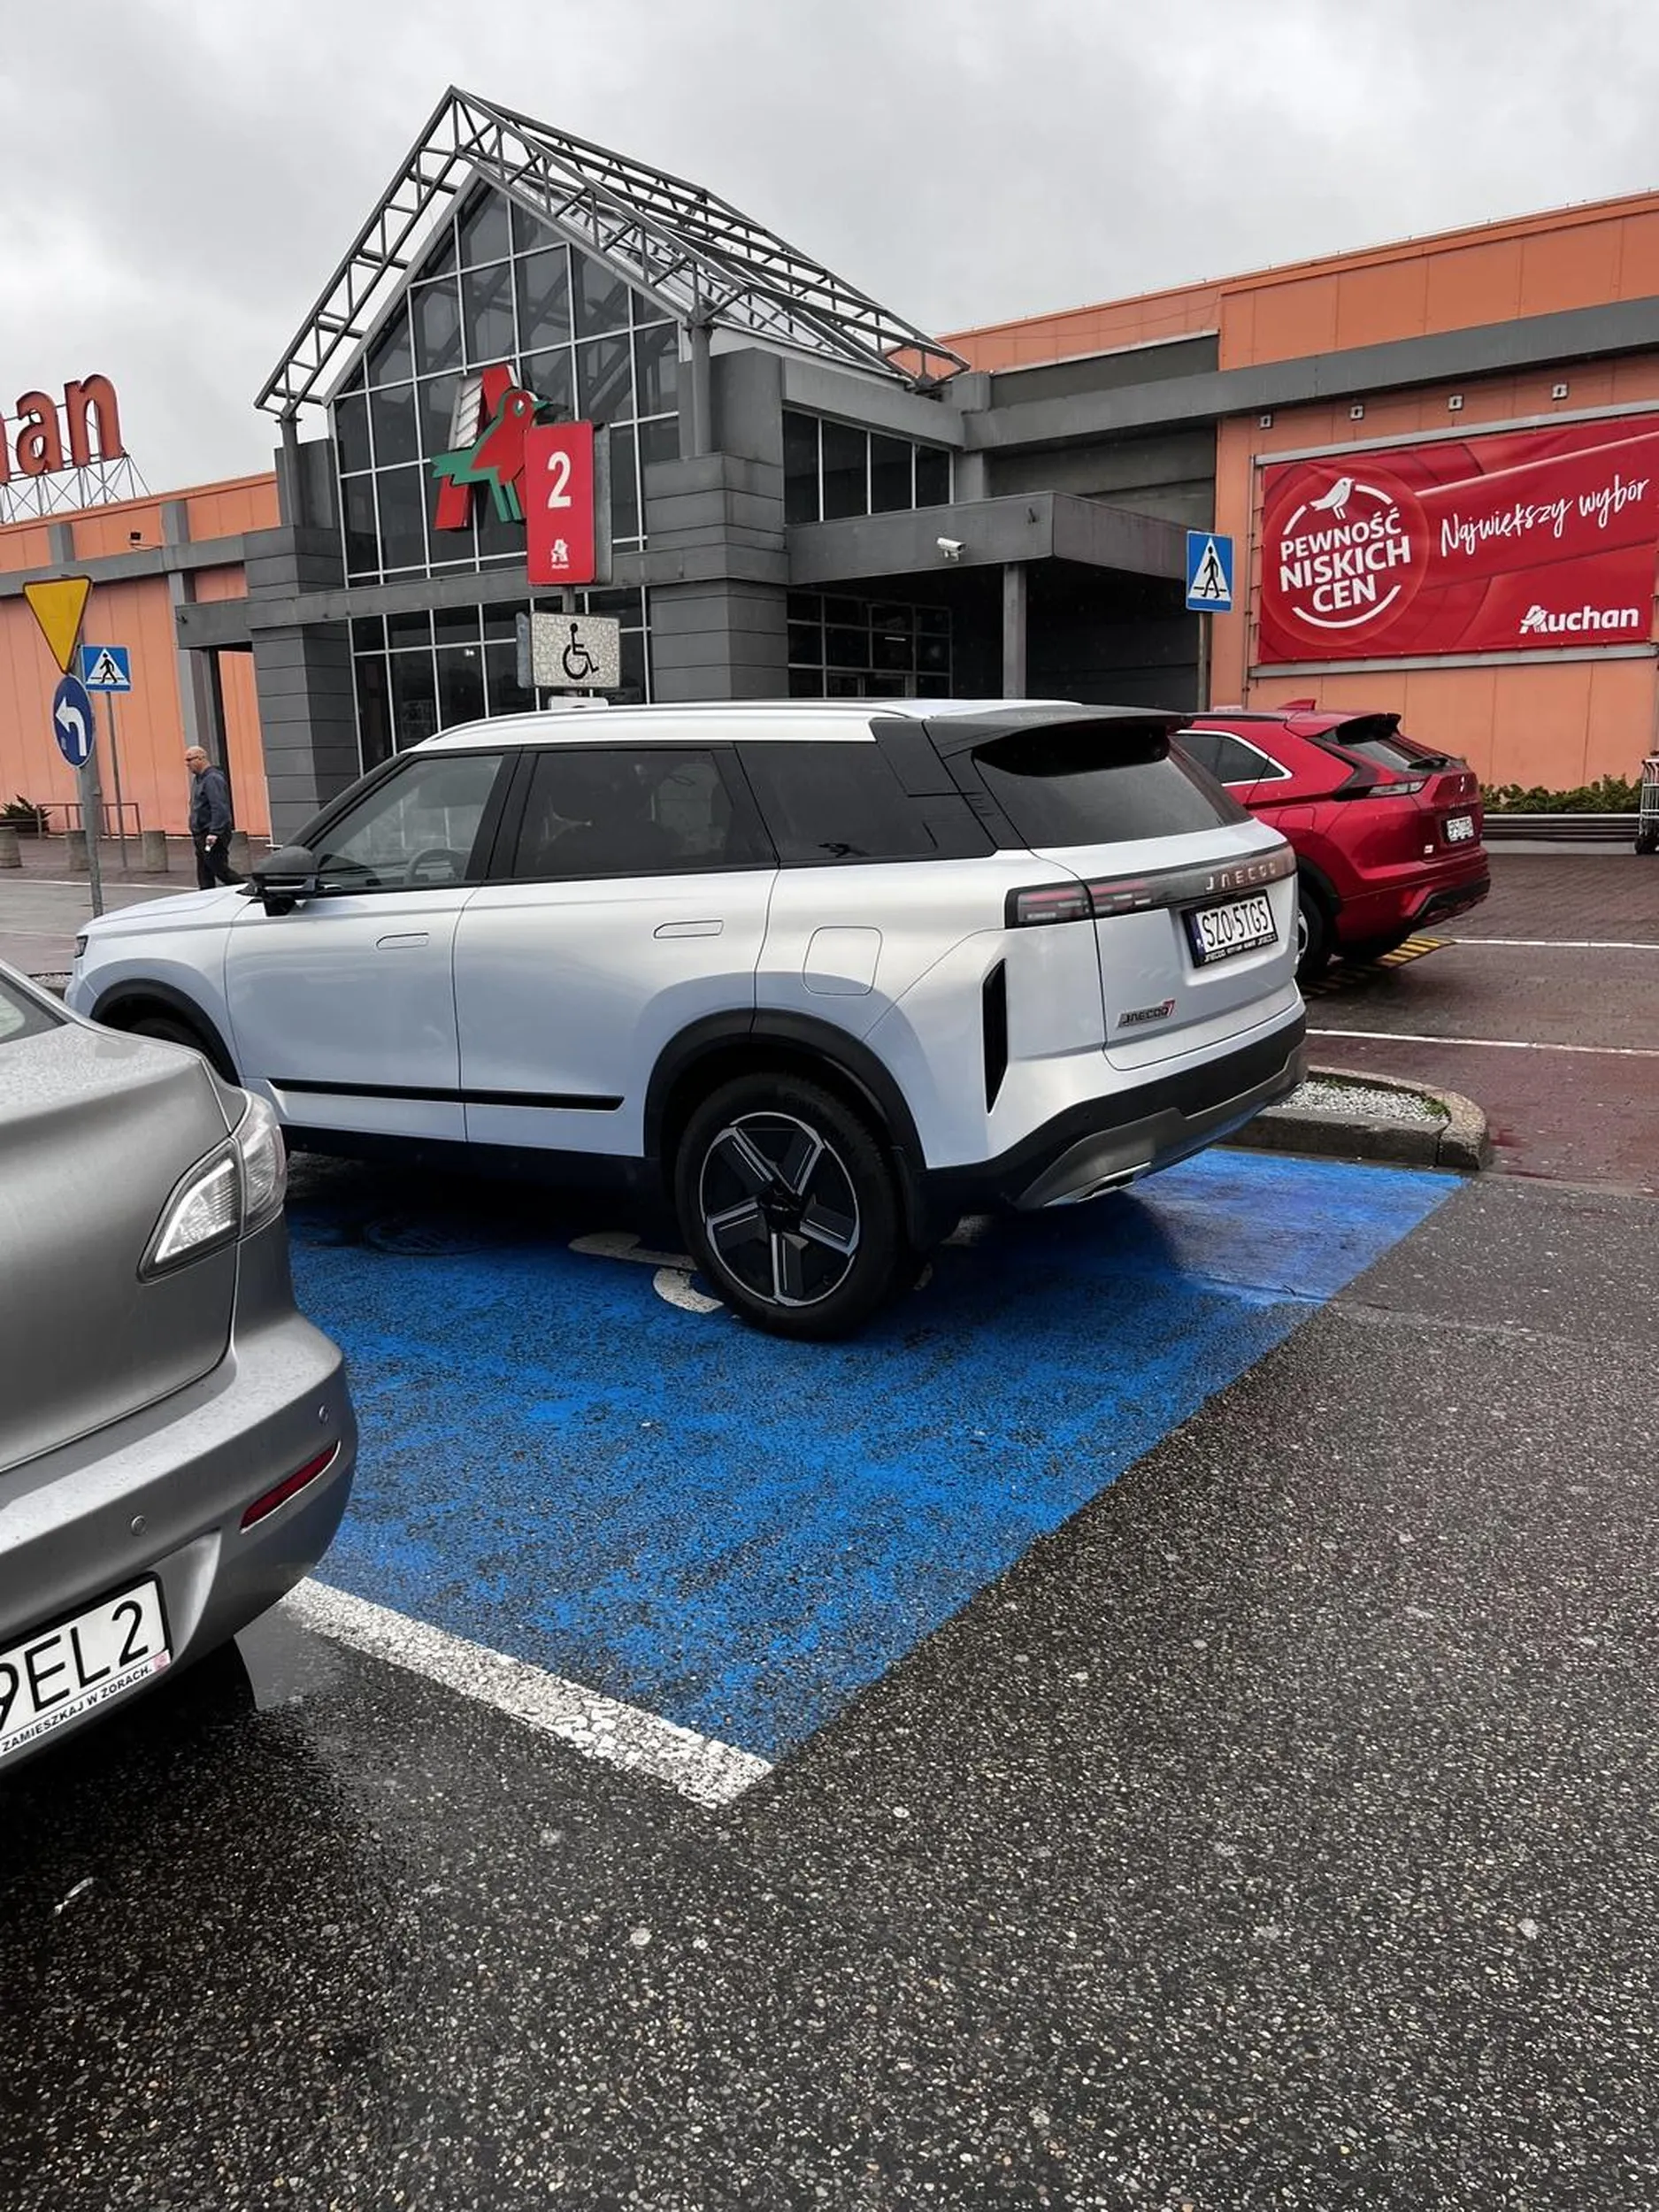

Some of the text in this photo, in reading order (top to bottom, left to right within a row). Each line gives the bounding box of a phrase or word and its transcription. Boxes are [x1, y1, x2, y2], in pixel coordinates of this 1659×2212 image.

[0, 373, 125, 484] an
[547, 450, 572, 510] 2
[1280, 507, 1402, 562] PEWNOŚĆ
[1440, 473, 1650, 557] Największy wybór
[1279, 535, 1411, 592] NISKICH
[1312, 573, 1377, 612] CEN
[1518, 604, 1640, 634] Auchan
[1202, 899, 1269, 948] SZO 5TG5
[1, 1701, 84, 1752] ZAMIESZKAJ
[86, 1692, 98, 1706] W
